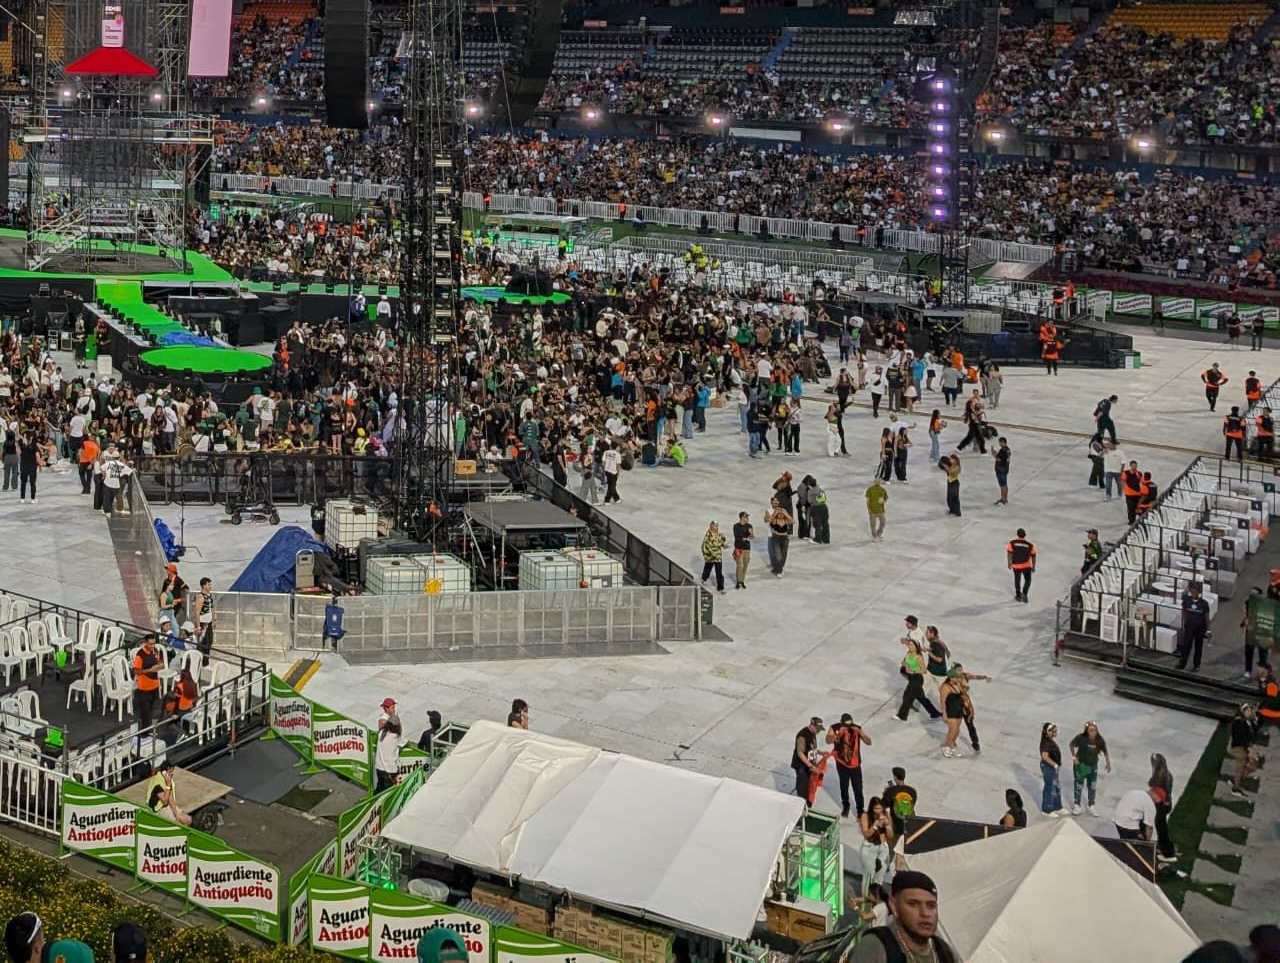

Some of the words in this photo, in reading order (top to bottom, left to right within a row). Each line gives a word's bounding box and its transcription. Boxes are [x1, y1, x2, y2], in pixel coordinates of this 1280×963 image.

[274, 701, 310, 717] Aguardiente
[273, 714, 311, 730] Antioqueño
[313, 725, 363, 741] guardiente
[314, 737, 365, 755] ntioqueño
[69, 807, 136, 829] Aguardien
[143, 841, 187, 862] Aguard
[141, 859, 187, 877] Antioq
[194, 866, 273, 887] Aguardiente
[193, 882, 273, 902] Antioqueño
[318, 925, 370, 942] Antio
